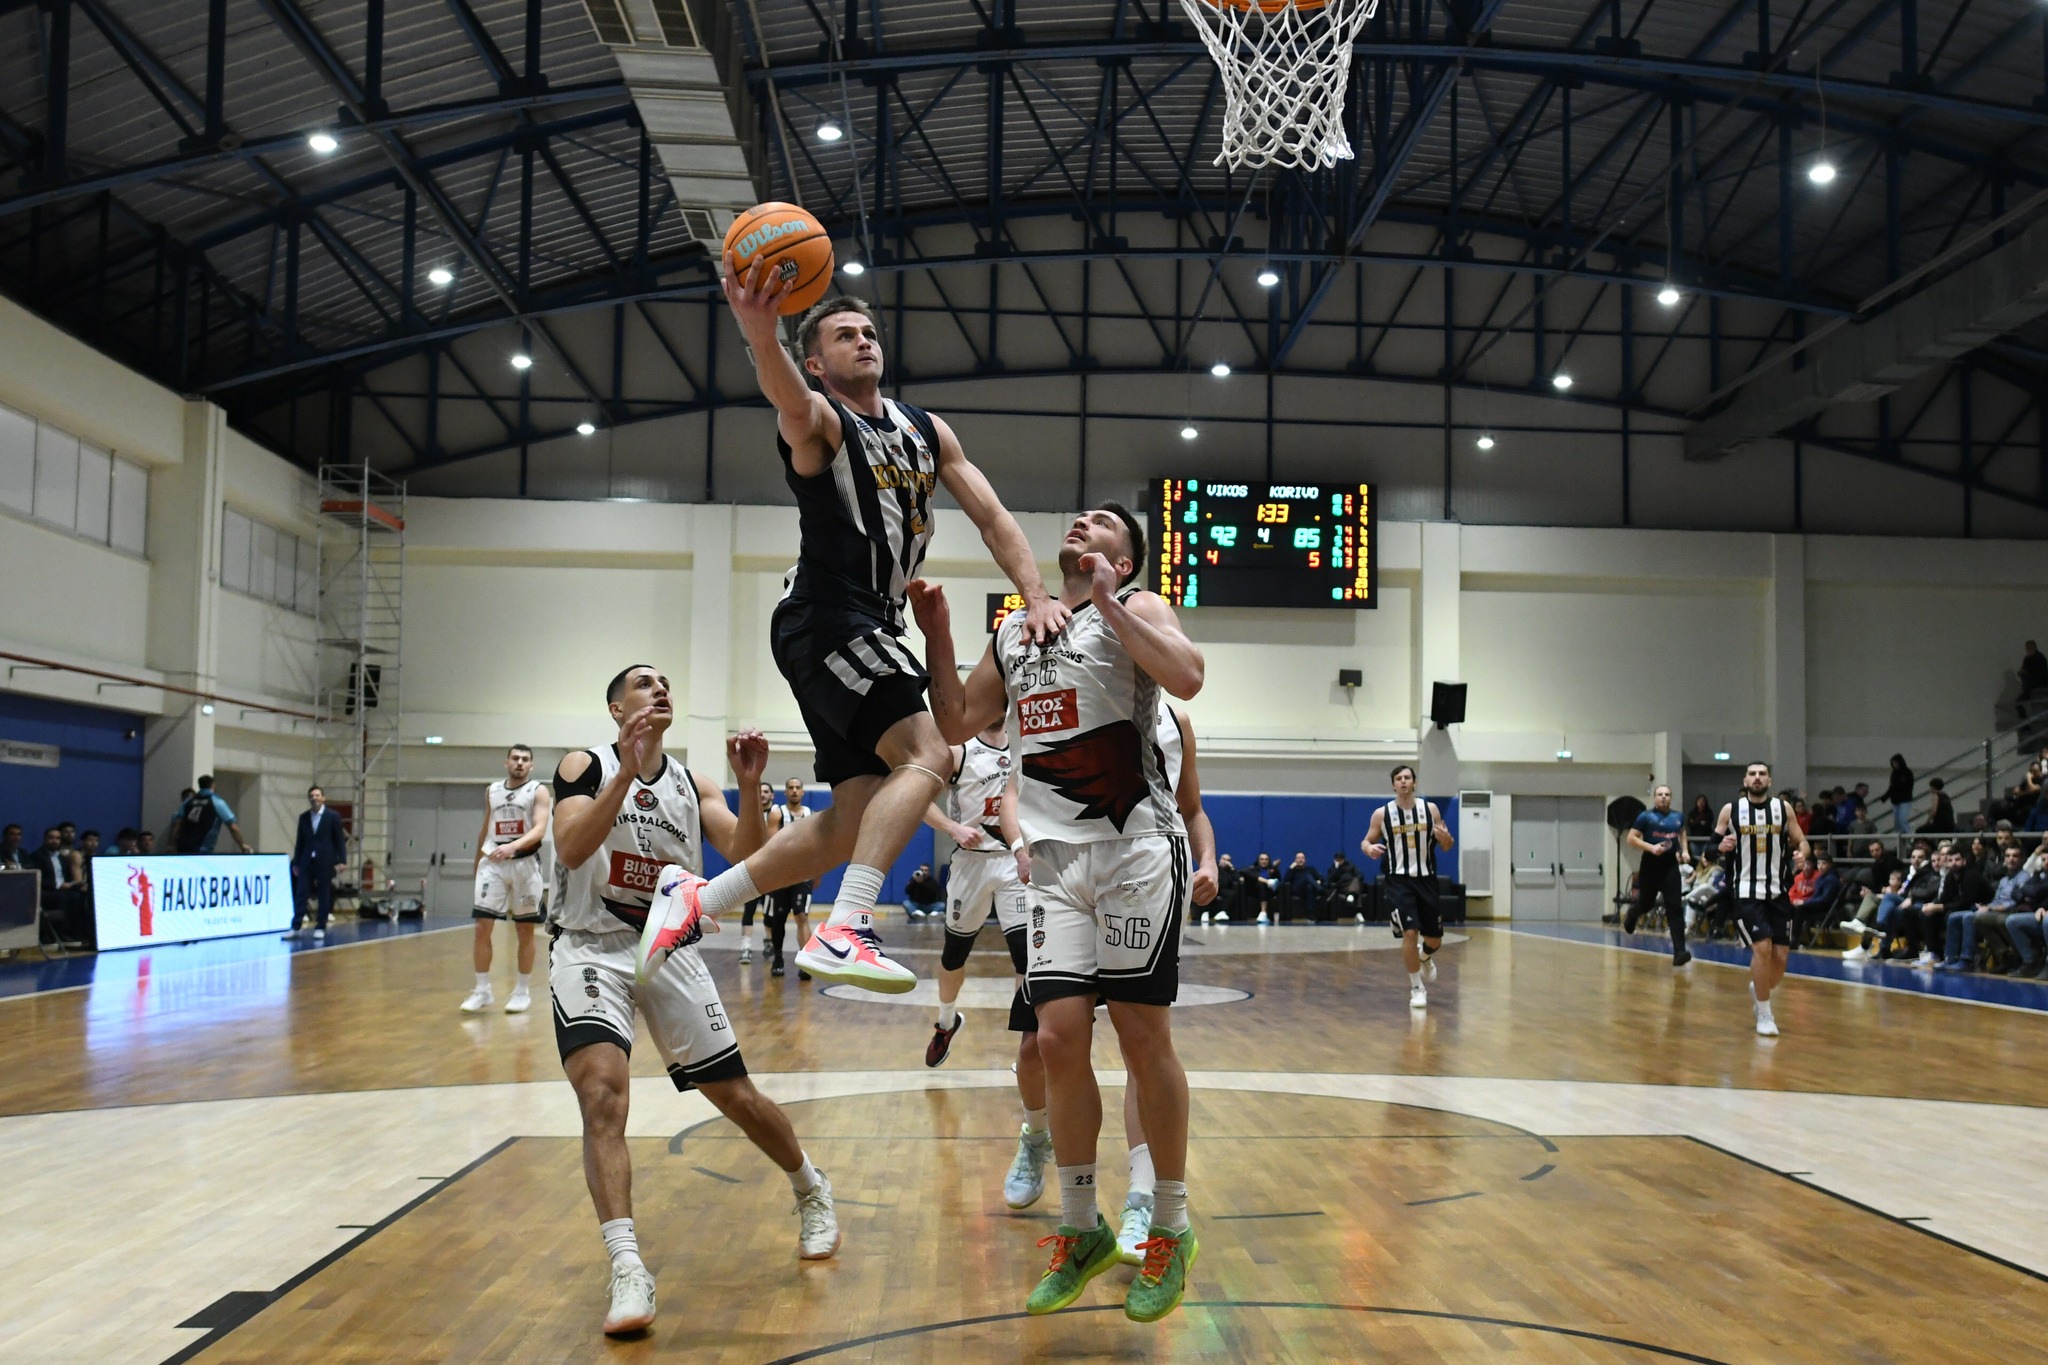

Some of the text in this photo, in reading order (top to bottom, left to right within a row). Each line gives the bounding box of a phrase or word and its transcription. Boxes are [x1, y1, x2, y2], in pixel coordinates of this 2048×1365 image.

[735, 220, 809, 259] Wilson
[1163, 479, 1171, 490] 2
[1177, 480, 1182, 490] 1
[1163, 490, 1181, 501] 3 2
[1206, 484, 1319, 499] VIKOS KORIVO
[1344, 494, 1352, 505] 2
[1163, 500, 1198, 512] 4 3
[1344, 505, 1352, 516] 4
[1360, 504, 1368, 516] 2
[1163, 511, 1171, 522] 5
[1257, 504, 1289, 522] 1:33
[1360, 515, 1368, 526] 4
[1210, 526, 1320, 548] 92 4 85
[1344, 526, 1352, 536] 4
[1174, 532, 1182, 543] 3
[1188, 531, 1198, 545] 5
[1344, 536, 1352, 547] 4
[1174, 542, 1182, 553] 3
[1344, 546, 1352, 557] 4
[1173, 553, 1182, 565] 2
[1206, 550, 1320, 568] 4 5
[1332, 556, 1343, 568] 11
[1344, 556, 1352, 568] 3
[1177, 574, 1182, 585] 1
[1188, 573, 1197, 585] 5
[1173, 585, 1181, 596] 4
[1344, 587, 1352, 600] 2
[1004, 594, 1026, 609] 1:3
[1020, 658, 1058, 692] 56
[623, 873, 659, 890] COLA
[162, 875, 271, 912] HAUSBRANDT
[1104, 913, 1151, 950] 56
[705, 1002, 727, 1032] 5
[1075, 1174, 1094, 1186] 23
